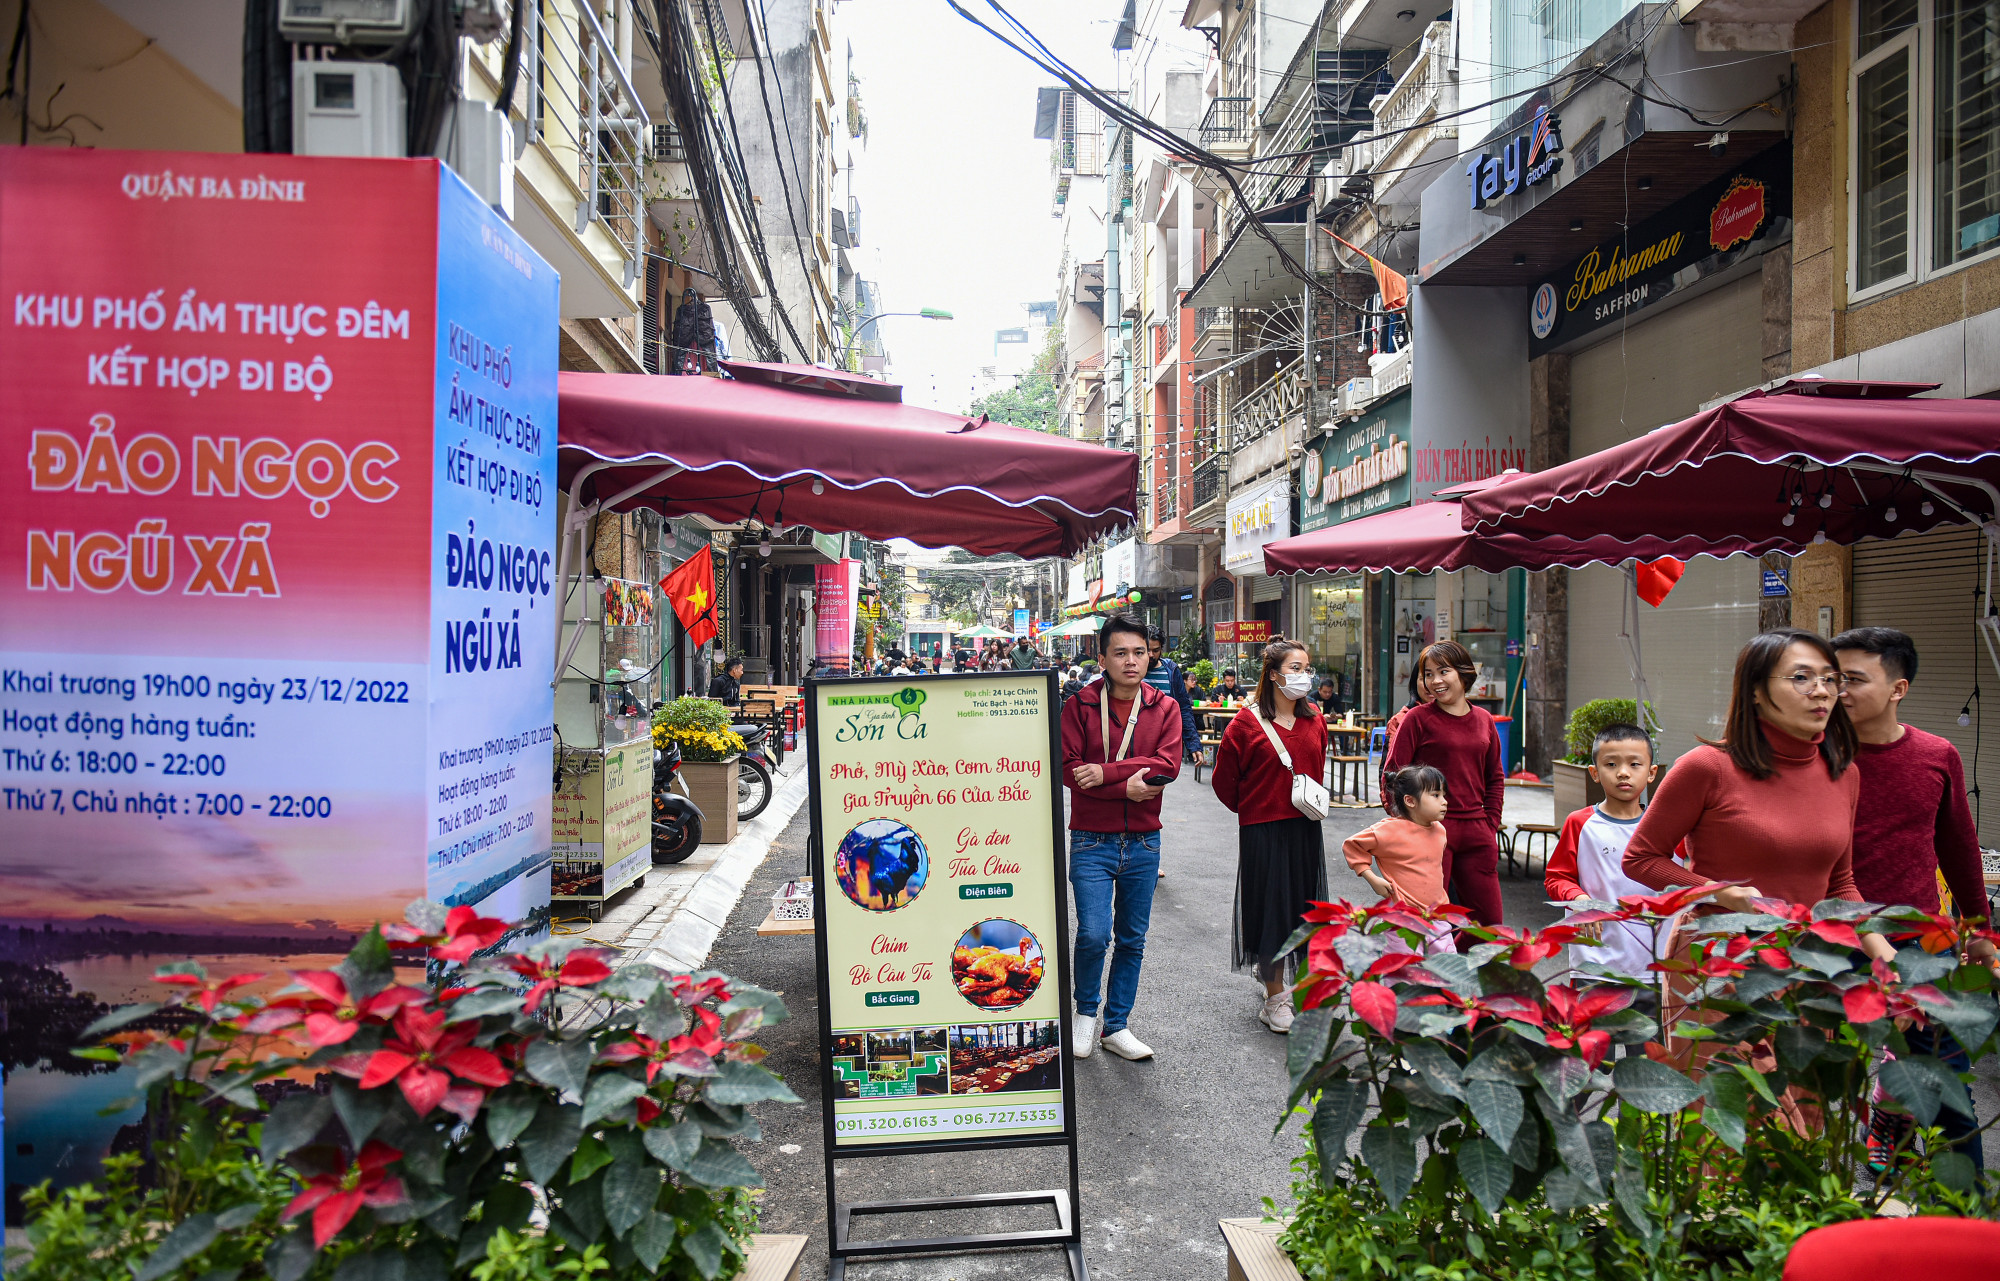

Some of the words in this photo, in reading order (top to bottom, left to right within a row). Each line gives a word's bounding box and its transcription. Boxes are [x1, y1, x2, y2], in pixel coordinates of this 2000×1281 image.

[122, 170, 195, 202] QUẬN
[200, 178, 233, 199] BA
[240, 175, 305, 202] ĐÌNH
[1525, 156, 1556, 187] GROUP
[1715, 201, 1758, 231] Bahraman
[1566, 231, 1685, 312] Bahraman
[14, 294, 83, 327] KHU
[93, 288, 166, 331] PHỐ
[236, 303, 327, 344] THỰC
[336, 300, 410, 339] ĐÊM
[1595, 283, 1648, 320] SAFFRON
[449, 320, 480, 372] KHU
[484, 344, 512, 390] PHỐ
[88, 345, 148, 386] KẾT
[157, 356, 230, 397] HỢP
[238, 360, 273, 391] ĐI
[284, 355, 333, 401] BỘ
[476, 396, 513, 450] THỰC
[516, 413, 541, 457] ĐÊM
[1346, 431, 1365, 454] LONG
[28, 413, 181, 495] ĐẢO
[192, 436, 400, 519] NGỌC
[1323, 465, 1341, 504] BÚN
[1340, 456, 1363, 498] THÁI
[1363, 443, 1381, 489] HẢI
[1381, 434, 1408, 481] SẢN
[1416, 440, 1441, 482] BÚN
[1444, 440, 1472, 482] THÁI
[1475, 435, 1497, 480] HẢI
[1501, 435, 1526, 474] SẢN
[447, 438, 474, 487] KẾT
[478, 456, 507, 505] HỢP
[510, 469, 522, 502] ĐI
[525, 470, 542, 516] BỘ
[1304, 498, 1311, 518] 24
[27, 518, 174, 595] NGŨ
[182, 522, 281, 598] XÃ
[446, 518, 494, 591] ĐẢO
[498, 543, 551, 609] NGỌC
[446, 607, 492, 673] NGŨ
[496, 608, 521, 669] XÃ
[1240, 622, 1255, 631] BÁNH
[2, 670, 53, 694] Khai
[60, 674, 136, 700] trương
[143, 673, 211, 698] 19h00
[217, 677, 275, 705] ngày
[281, 676, 409, 704] 23/12/2022
[832, 694, 855, 706] NHÀ
[858, 693, 890, 705] HÀNG
[964, 690, 977, 698] Địa
[1003, 689, 1016, 697] Lạc
[1017, 688, 1038, 696] Chính
[990, 699, 1008, 708] Bạch
[1025, 698, 1039, 706] Nội
[2, 709, 58, 739] Hoạt
[65, 712, 124, 741] động
[131, 713, 189, 742] hàng
[835, 706, 885, 742] Sơn
[896, 713, 928, 740] Ca
[865, 709, 880, 724] Gia
[957, 710, 984, 718] Hotline
[989, 708, 1039, 717] 0913.20.6163
[2, 748, 45, 773] Thứ
[51, 750, 70, 773] 6:
[78, 751, 137, 774] 18:00
[163, 753, 226, 777] 22:00
[439, 750, 457, 770] Khai
[459, 746, 483, 765] trương
[484, 738, 504, 758] 19h00
[505, 735, 520, 756] ngày
[829, 762, 869, 780] Phở,
[875, 761, 907, 783] Mỳ
[912, 758, 950, 777] Xào,
[955, 758, 992, 775] Cơm
[995, 756, 1041, 778] Rang
[438, 783, 458, 804] Hoạt
[460, 777, 479, 798] động
[480, 771, 497, 790] hàng
[843, 793, 871, 814] Gia
[874, 783, 934, 812] Truyền
[937, 789, 956, 804] 66
[962, 786, 994, 804] Cửa
[998, 779, 1032, 802] Bắc
[2, 788, 45, 813] Thứ
[50, 789, 65, 816] 7,
[72, 789, 118, 814] Chủ
[125, 792, 177, 820] nhật
[183, 797, 190, 814] :
[196, 793, 244, 816] 7:00
[269, 795, 332, 819] 22:00
[438, 814, 453, 836] Thứ
[454, 812, 461, 828] 6:
[464, 803, 482, 826] 18:00
[489, 794, 507, 816] 22:00
[437, 847, 453, 868] Thứ
[454, 843, 460, 863] 7,
[461, 835, 477, 858] Chủ
[478, 830, 494, 851] nhật
[498, 821, 512, 842] 7:00
[517, 812, 534, 832] 22:00
[956, 827, 980, 854] Gà
[985, 829, 1011, 846] đen
[983, 855, 1021, 876] Chùa
[965, 887, 986, 897] Điện
[988, 886, 1007, 895] Biên
[871, 933, 909, 955] Chim
[877, 962, 906, 984] Câu
[912, 962, 933, 983] Ta
[871, 993, 888, 1004] Bắc
[889, 994, 915, 1004] Giang
[836, 1115, 938, 1131] 091.320.6163
[953, 1108, 1057, 1126] 096.727.5335
